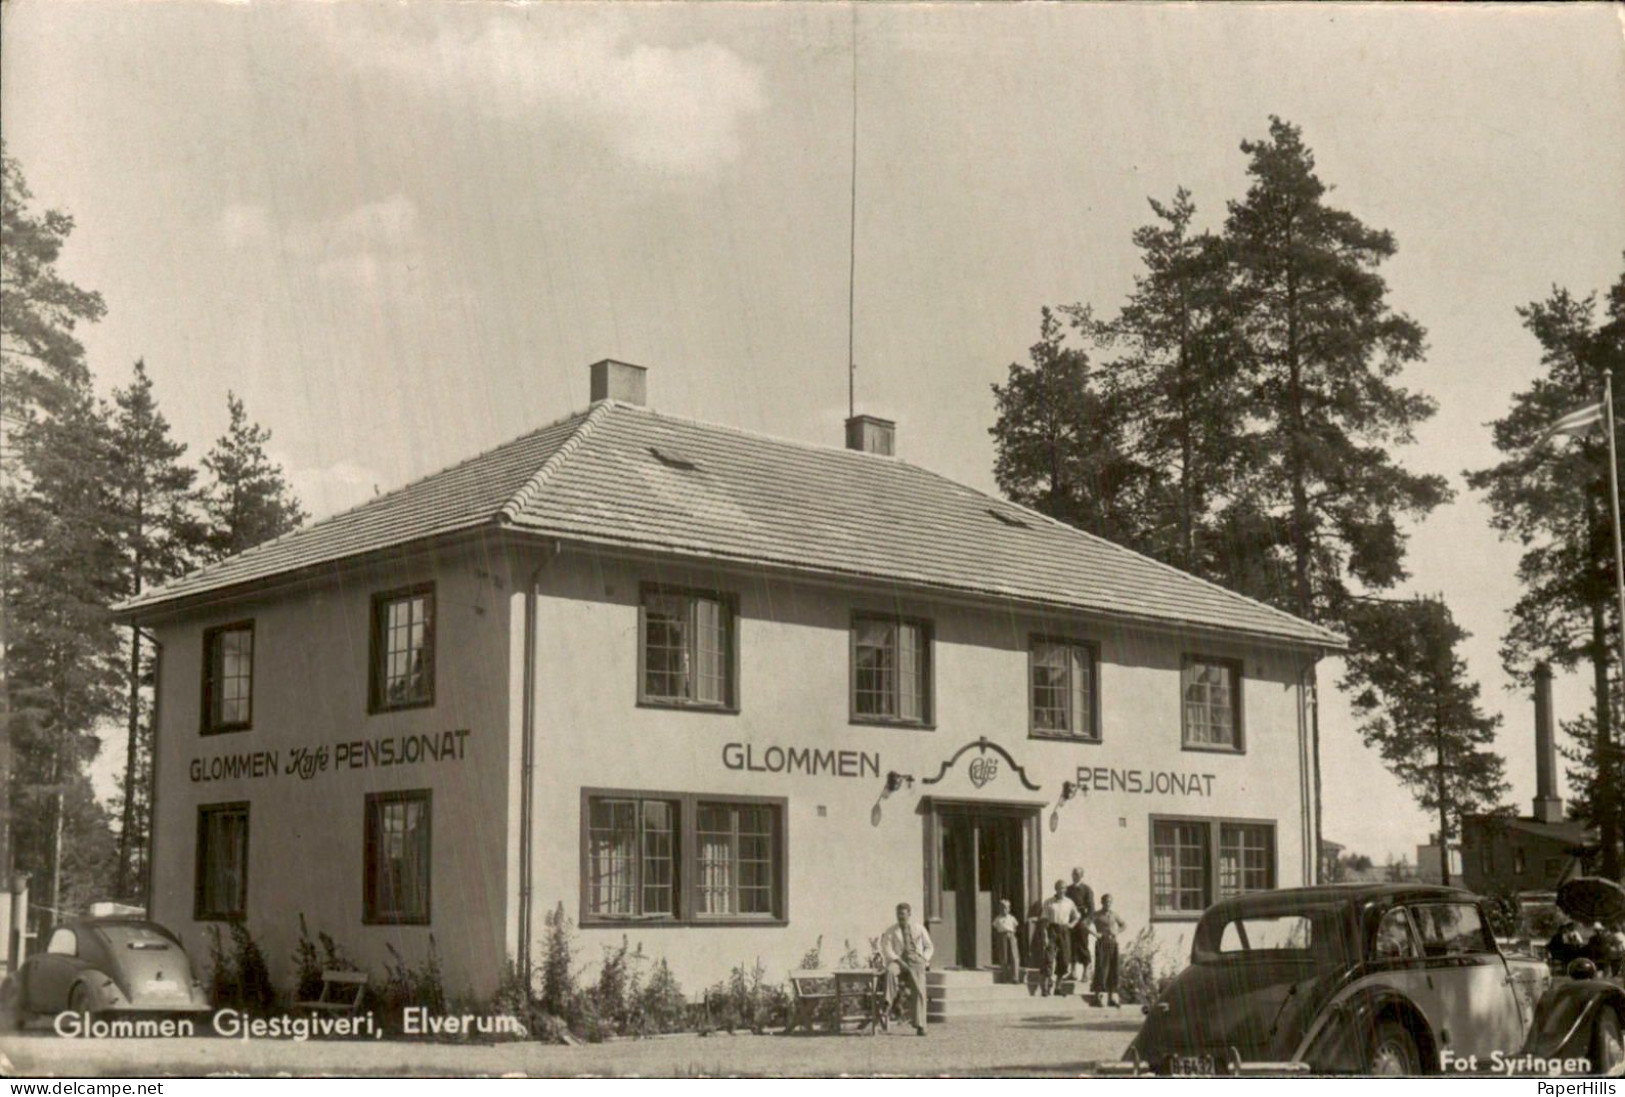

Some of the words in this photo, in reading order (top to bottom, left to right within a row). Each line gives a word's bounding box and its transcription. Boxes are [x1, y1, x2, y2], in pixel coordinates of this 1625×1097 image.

[190, 751, 279, 782] GLOMMEN
[285, 746, 329, 780] Kafé
[335, 729, 471, 770] PENSJONAT
[722, 742, 880, 779] GLOMMEN
[1076, 766, 1216, 797] PENSJONAT
